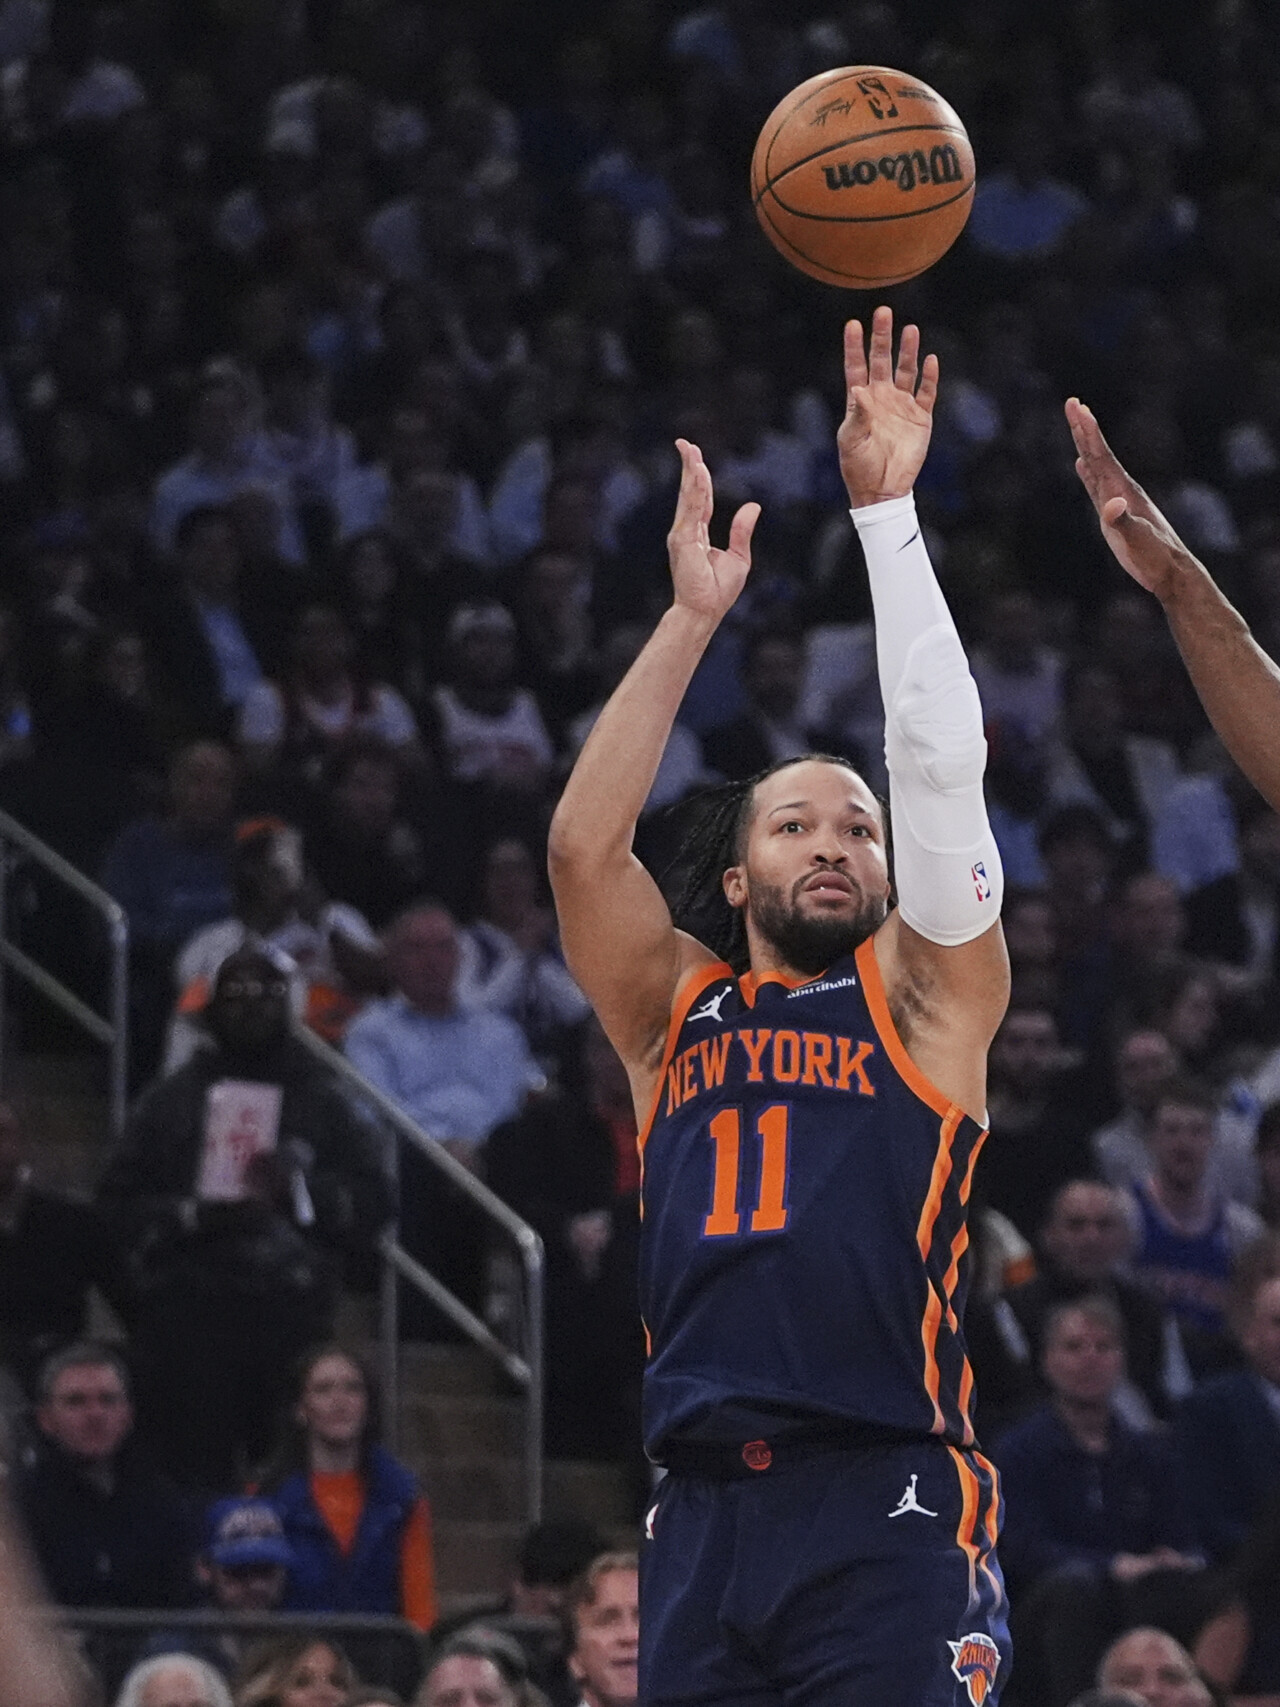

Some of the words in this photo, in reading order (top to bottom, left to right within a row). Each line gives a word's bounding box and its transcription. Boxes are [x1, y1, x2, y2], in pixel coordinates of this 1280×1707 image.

[822, 143, 963, 191] Wilson
[666, 1032, 732, 1117] NEW
[738, 1029, 875, 1096] YORK
[704, 1105, 788, 1235] 11
